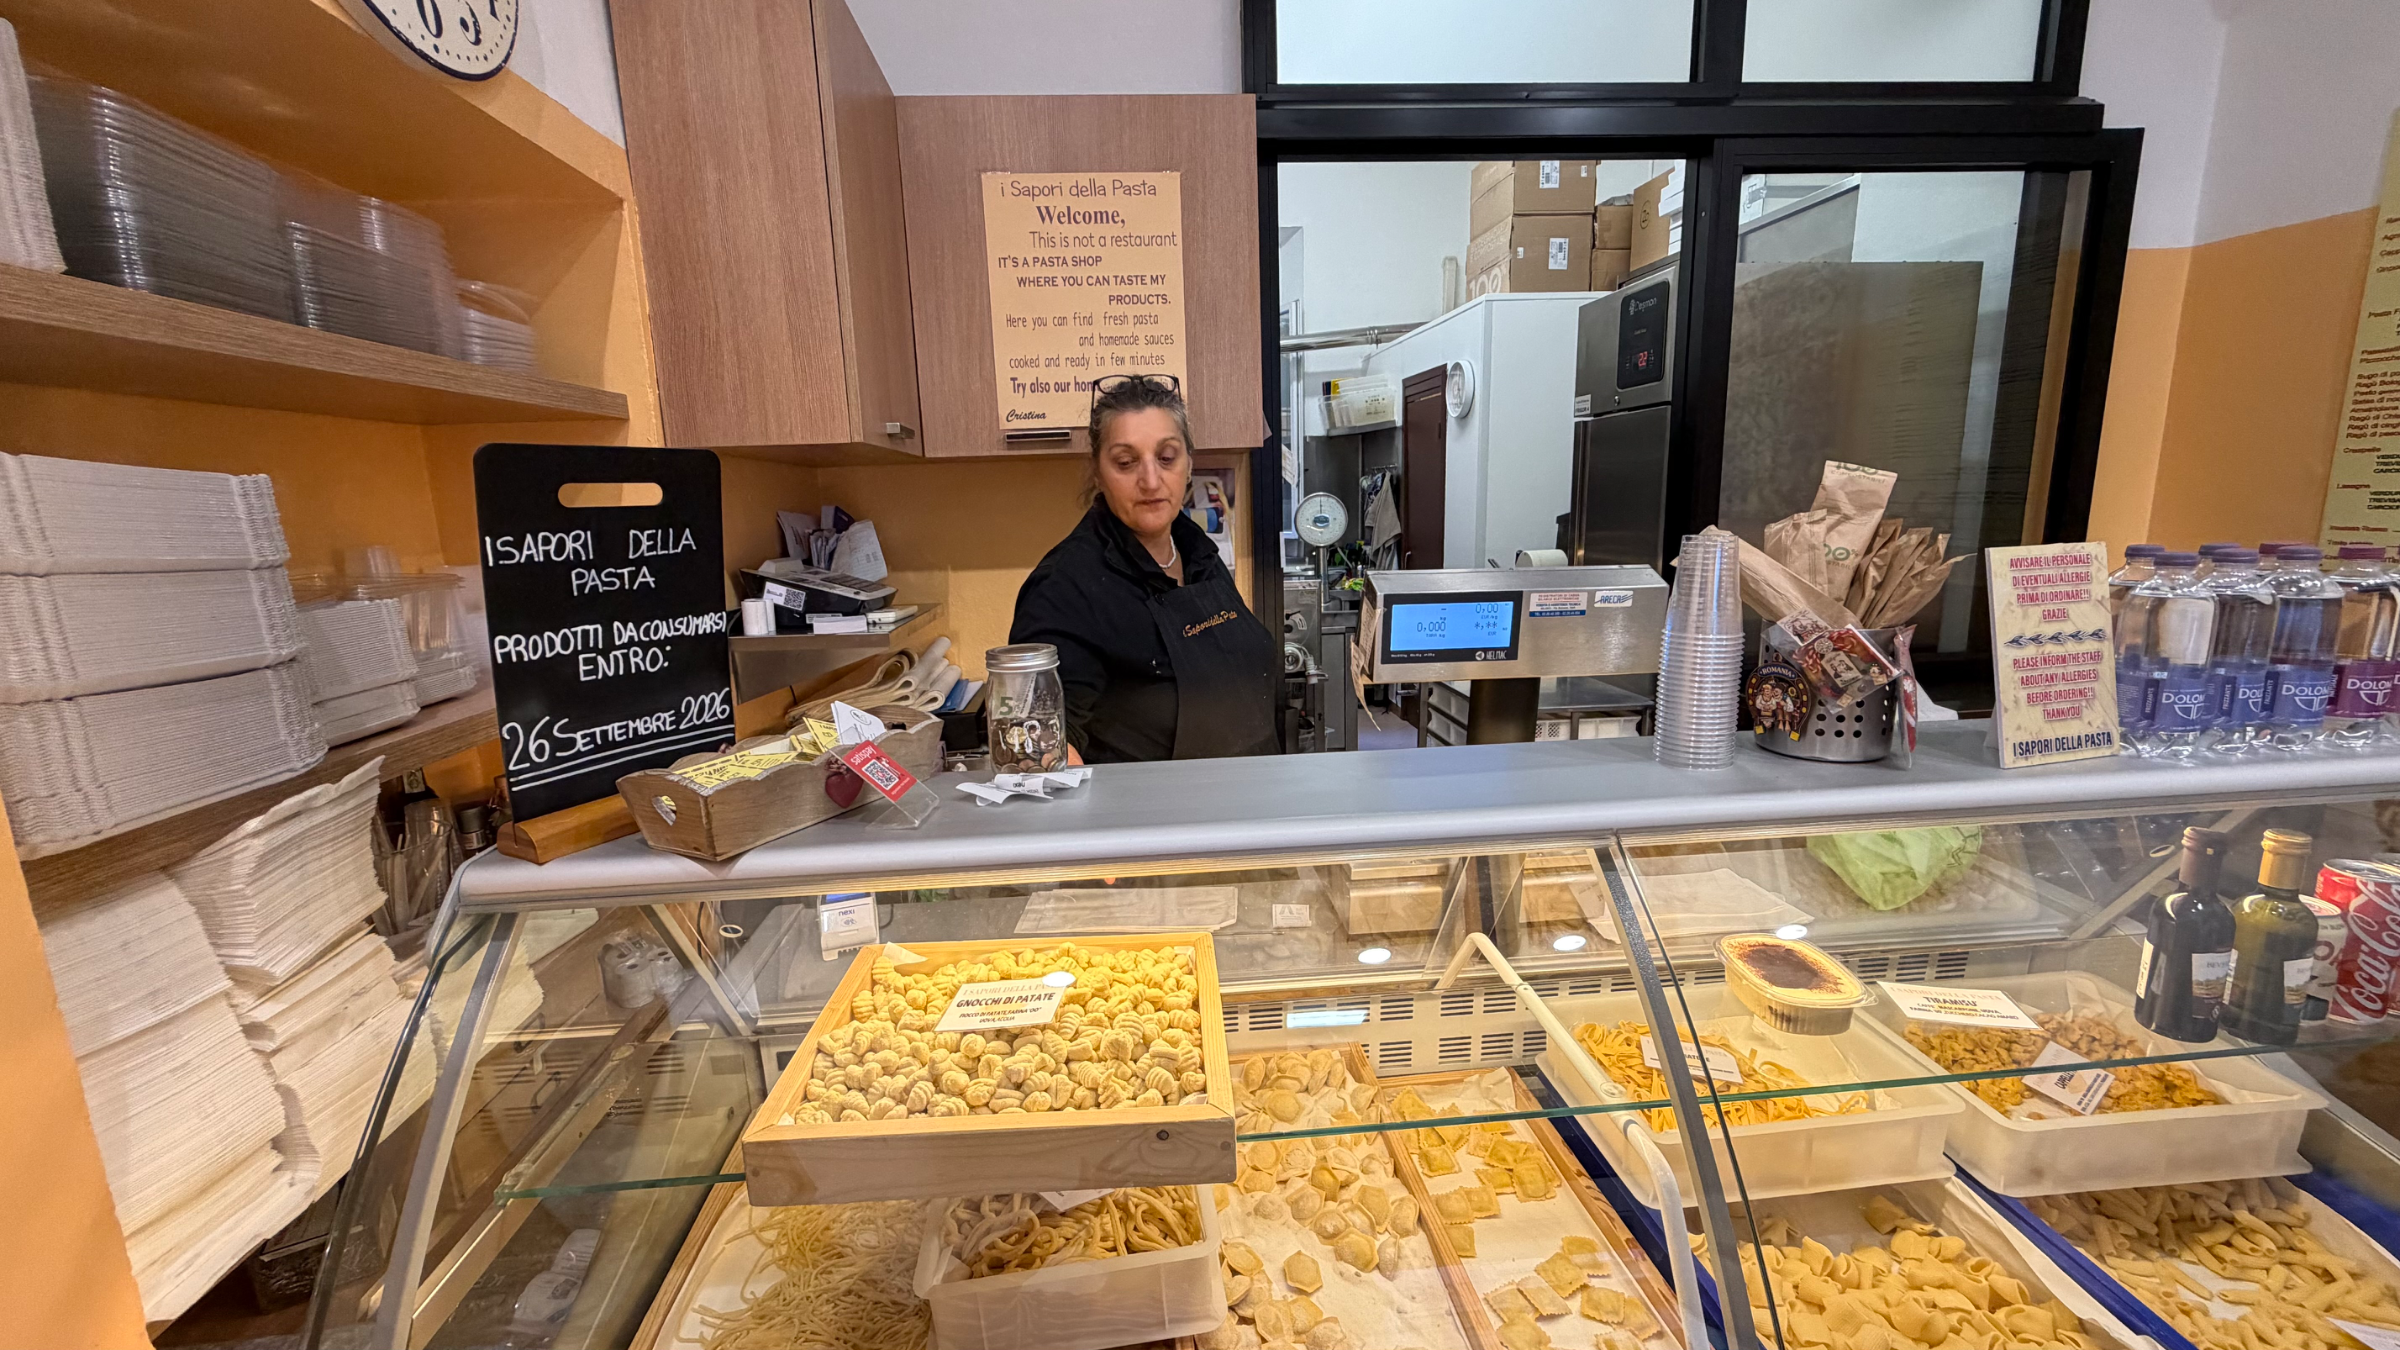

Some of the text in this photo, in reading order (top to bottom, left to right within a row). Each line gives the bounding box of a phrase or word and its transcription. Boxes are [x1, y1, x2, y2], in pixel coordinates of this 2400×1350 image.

[1000, 178, 1157, 201] i Sapori della Pasta
[1036, 205, 1126, 228] Welcome,
[1029, 231, 1178, 248] This is not a restaurant
[998, 255, 1102, 269] IT'S A PASTA SHOP
[1017, 274, 1166, 288] WHERE YOU CAN TASTE MY
[1108, 294, 1171, 306] PRODUCTS.
[1006, 311, 1159, 331] Here you can find fresh pasta
[1079, 332, 1175, 347] and homemade sauces
[1009, 352, 1165, 370] cooked and ready in few minutes
[1010, 377, 1027, 398] Try
[1030, 377, 1050, 393] also
[1054, 380, 1070, 393] our
[1006, 409, 1046, 423] Cristina
[628, 528, 697, 559] DELLA
[2010, 554, 2091, 570] AVVISARE IL PERSONALE
[571, 566, 656, 596] PASTA
[2012, 571, 2091, 587] DI EVENTUALI ALLERGIE
[2017, 588, 2090, 604] PRIMA DI ORDINARE!!
[2042, 607, 2067, 620] GRAZIE
[1416, 622, 1446, 632] 0,000
[494, 623, 603, 664] PRODOTTI
[578, 645, 671, 682] ENTRO:
[1486, 650, 1507, 660] HELMAC
[2013, 651, 2101, 669] PLEASE INFORM THE STAFF
[1762, 665, 1793, 678] ROMANIA
[2021, 669, 2097, 686] ABOUT ANY ALLERGIES
[2027, 686, 2094, 704] BEFORE ORDERING!!
[2145, 687, 2155, 713] FRIZZANTE
[2222, 684, 2232, 710] FRIZZANTE
[1000, 696, 1013, 715] 5
[2043, 705, 2080, 719] THANK YOU
[501, 688, 730, 771] 26 SETTEMBRE 2026
[2013, 731, 2113, 757] I SAPORI DELLA PASTA
[838, 909, 855, 917] nexi
[957, 992, 1056, 1008] GNOCCHI DI PATATE
